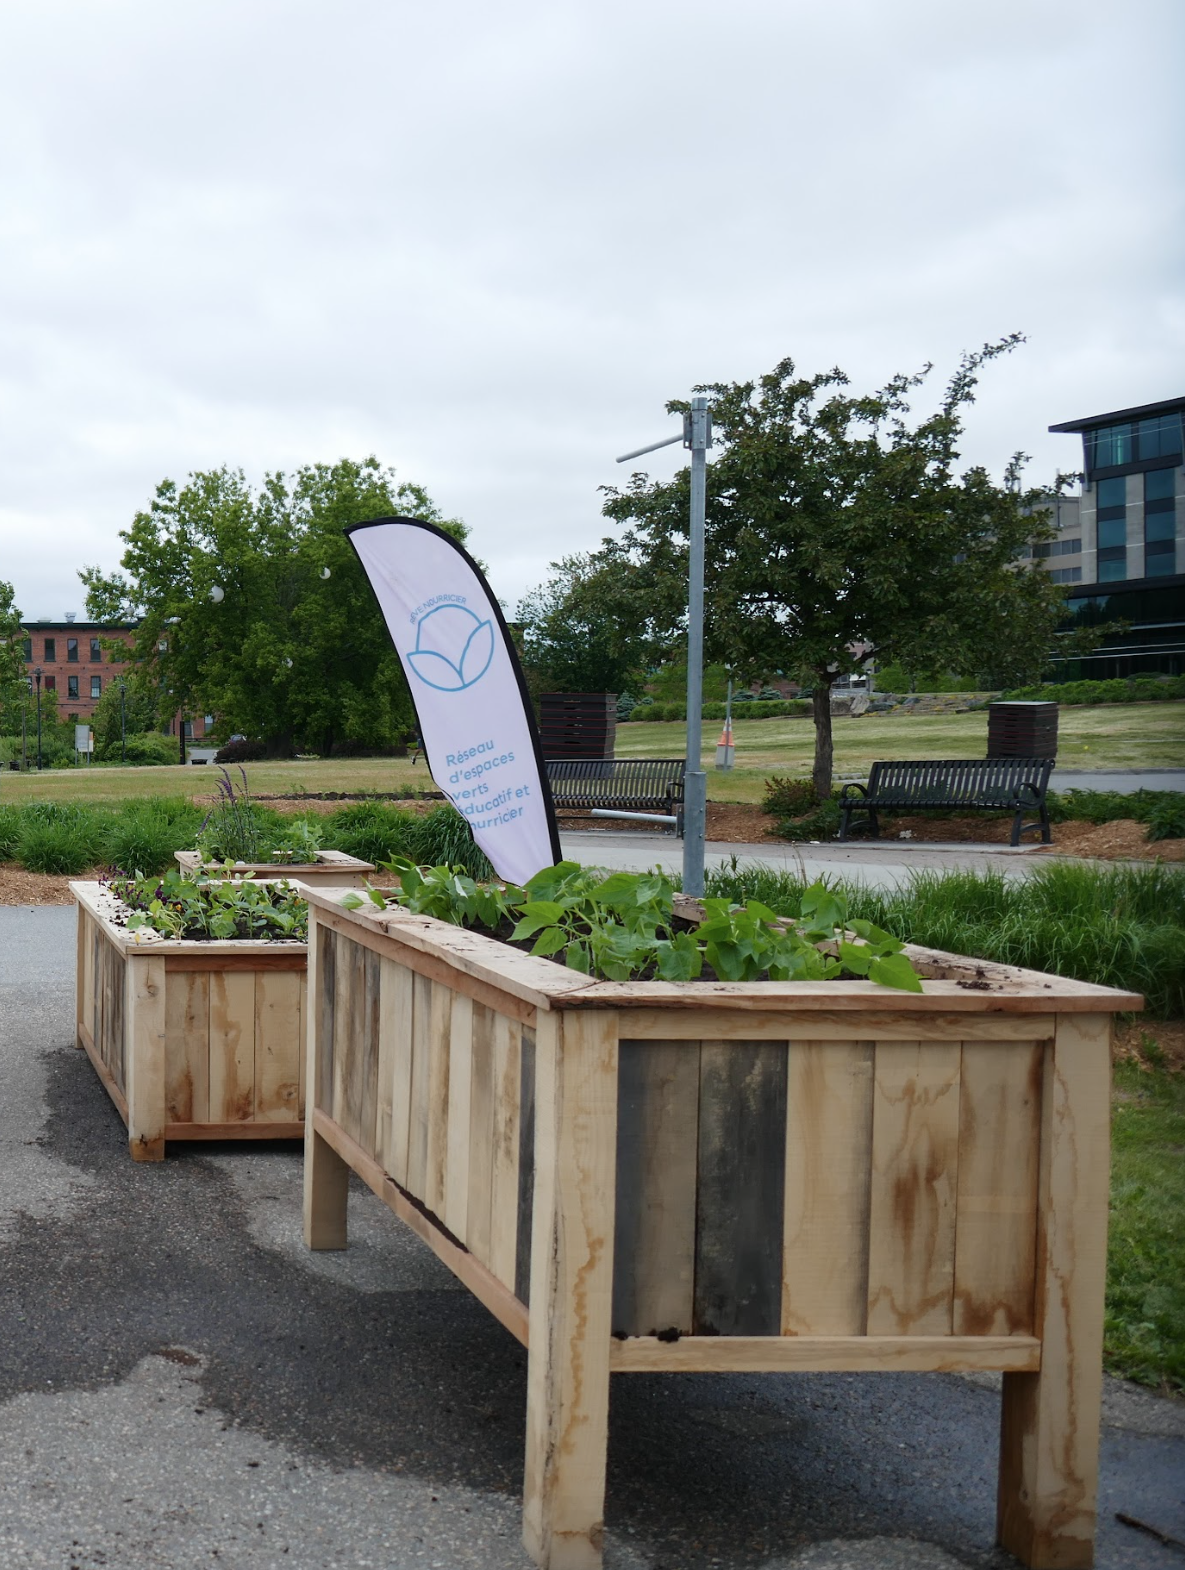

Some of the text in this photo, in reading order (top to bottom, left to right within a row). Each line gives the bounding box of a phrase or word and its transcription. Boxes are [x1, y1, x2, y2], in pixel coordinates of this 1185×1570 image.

[423, 594, 467, 609] NOURRICIER
[446, 739, 495, 767] Réseau
[449, 751, 515, 784] d'espaces
[452, 782, 489, 801] verts
[515, 784, 531, 798] et
